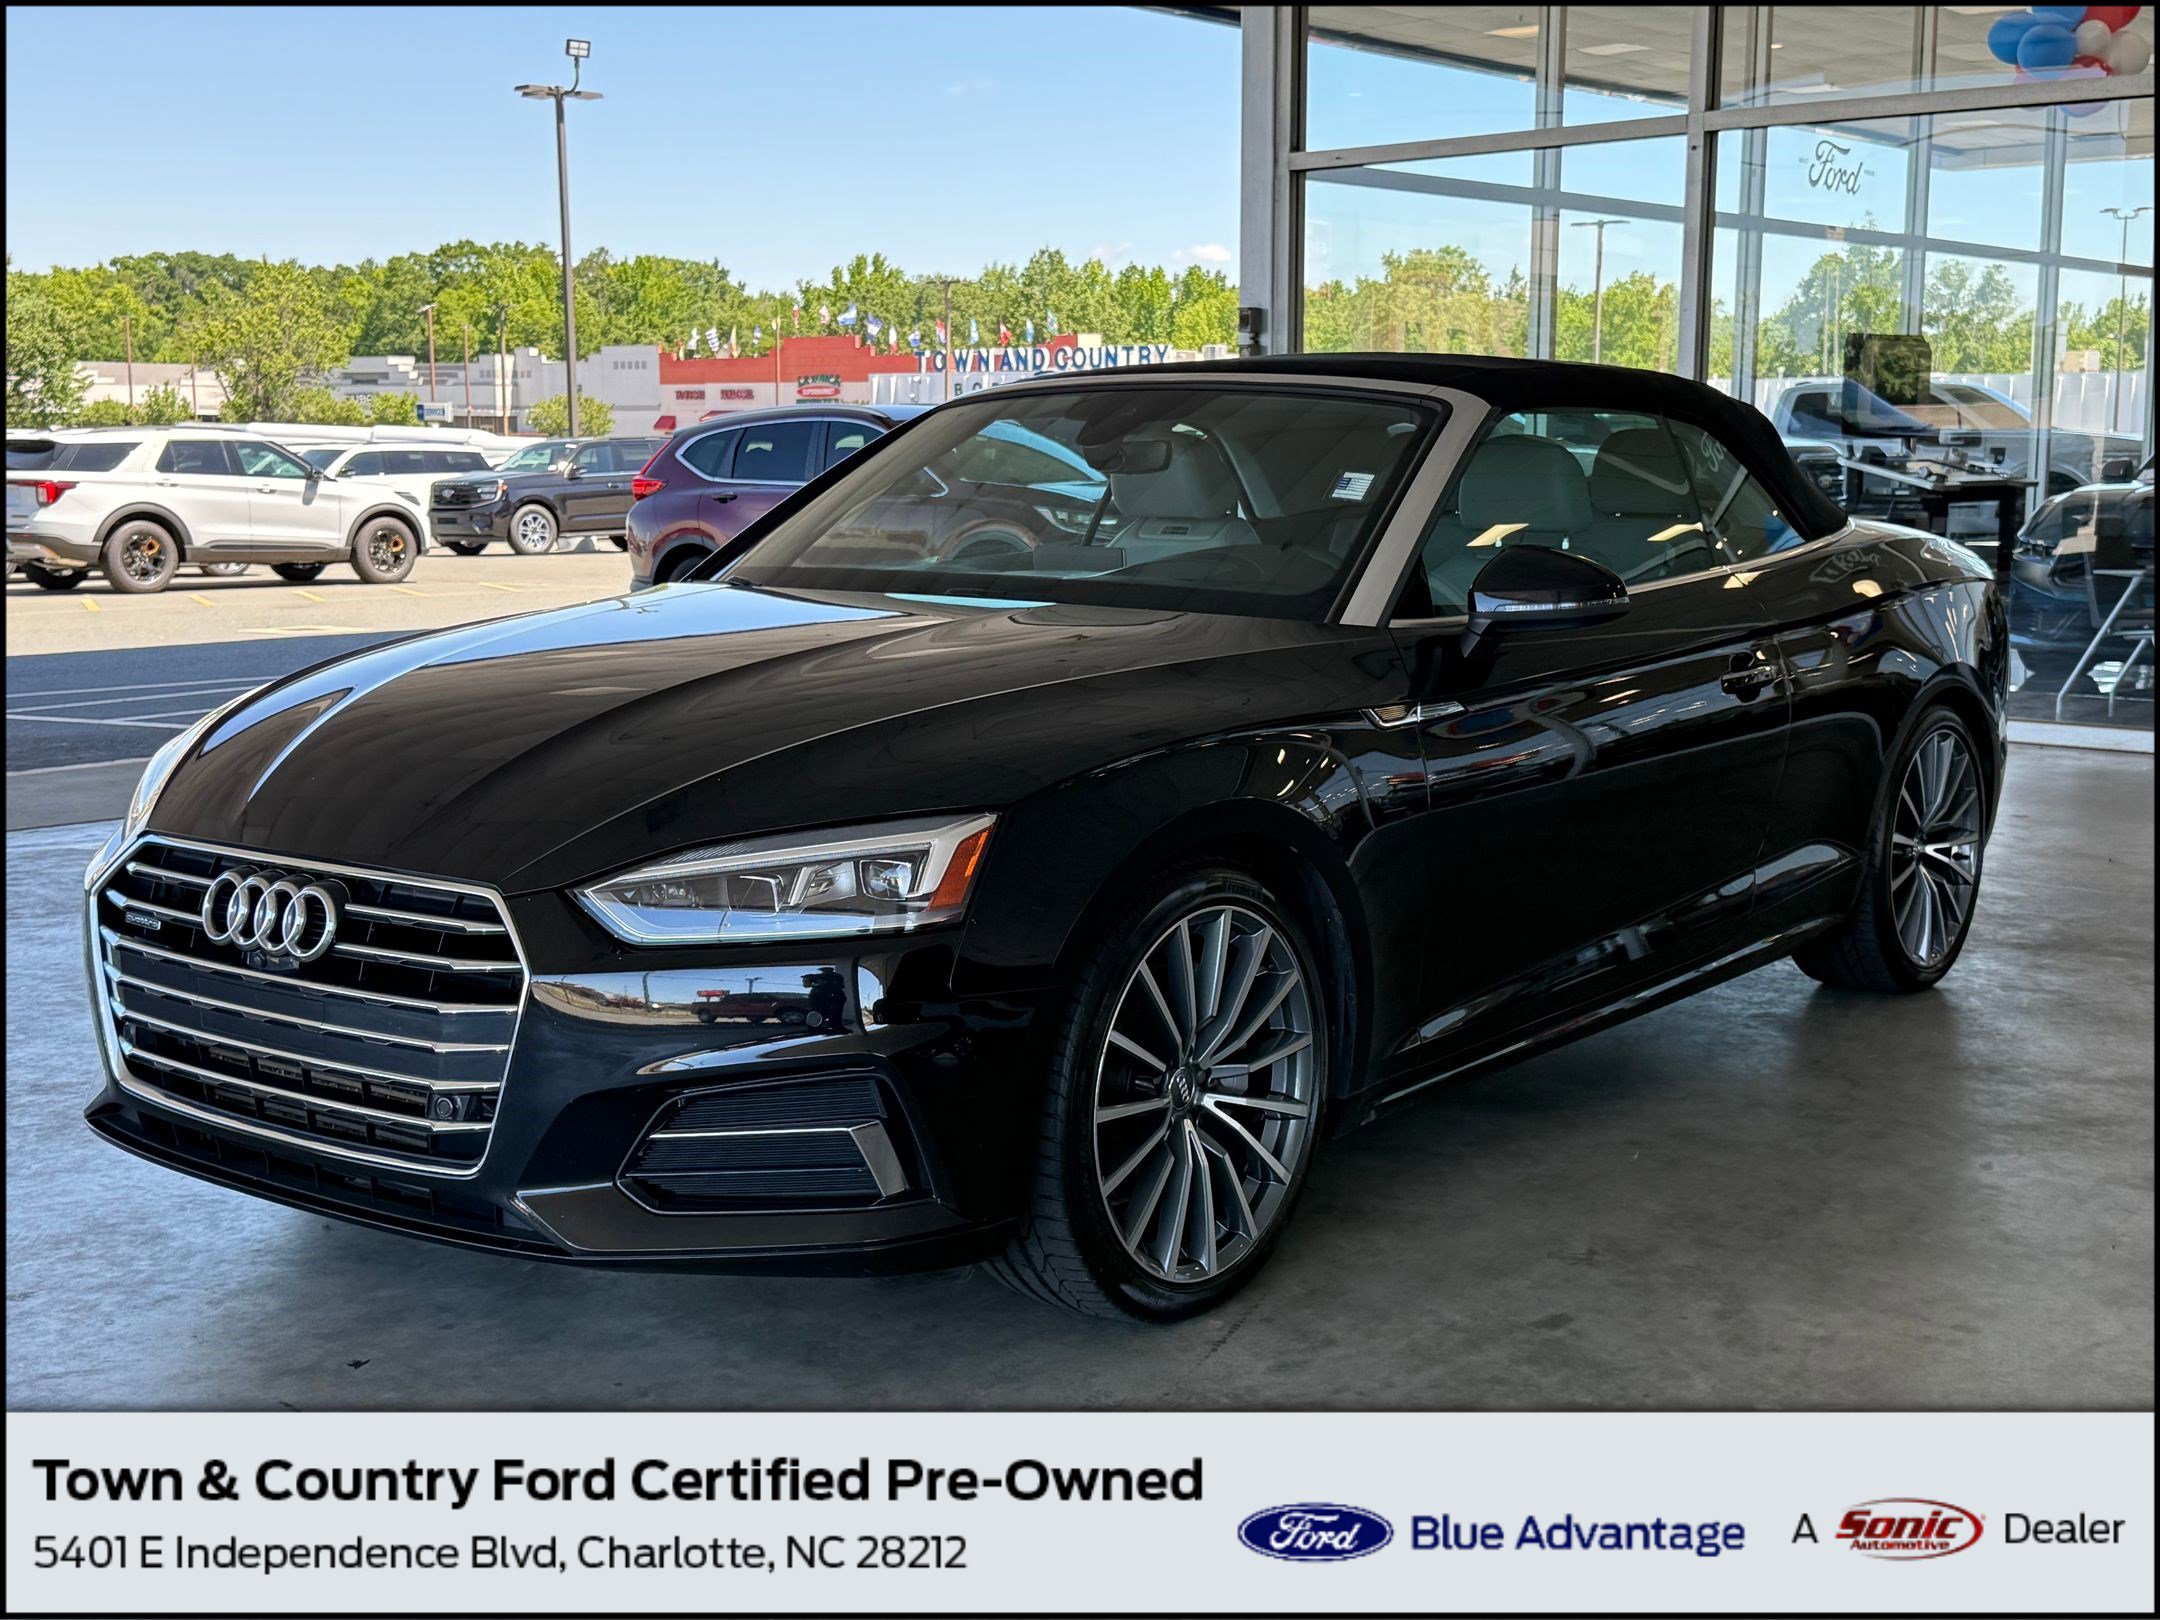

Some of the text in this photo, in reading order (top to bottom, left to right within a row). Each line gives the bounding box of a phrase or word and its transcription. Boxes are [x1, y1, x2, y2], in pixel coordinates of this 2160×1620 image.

[1808, 139, 1863, 195] Ford
[914, 344, 1170, 373] TOWN AND COUNTRY
